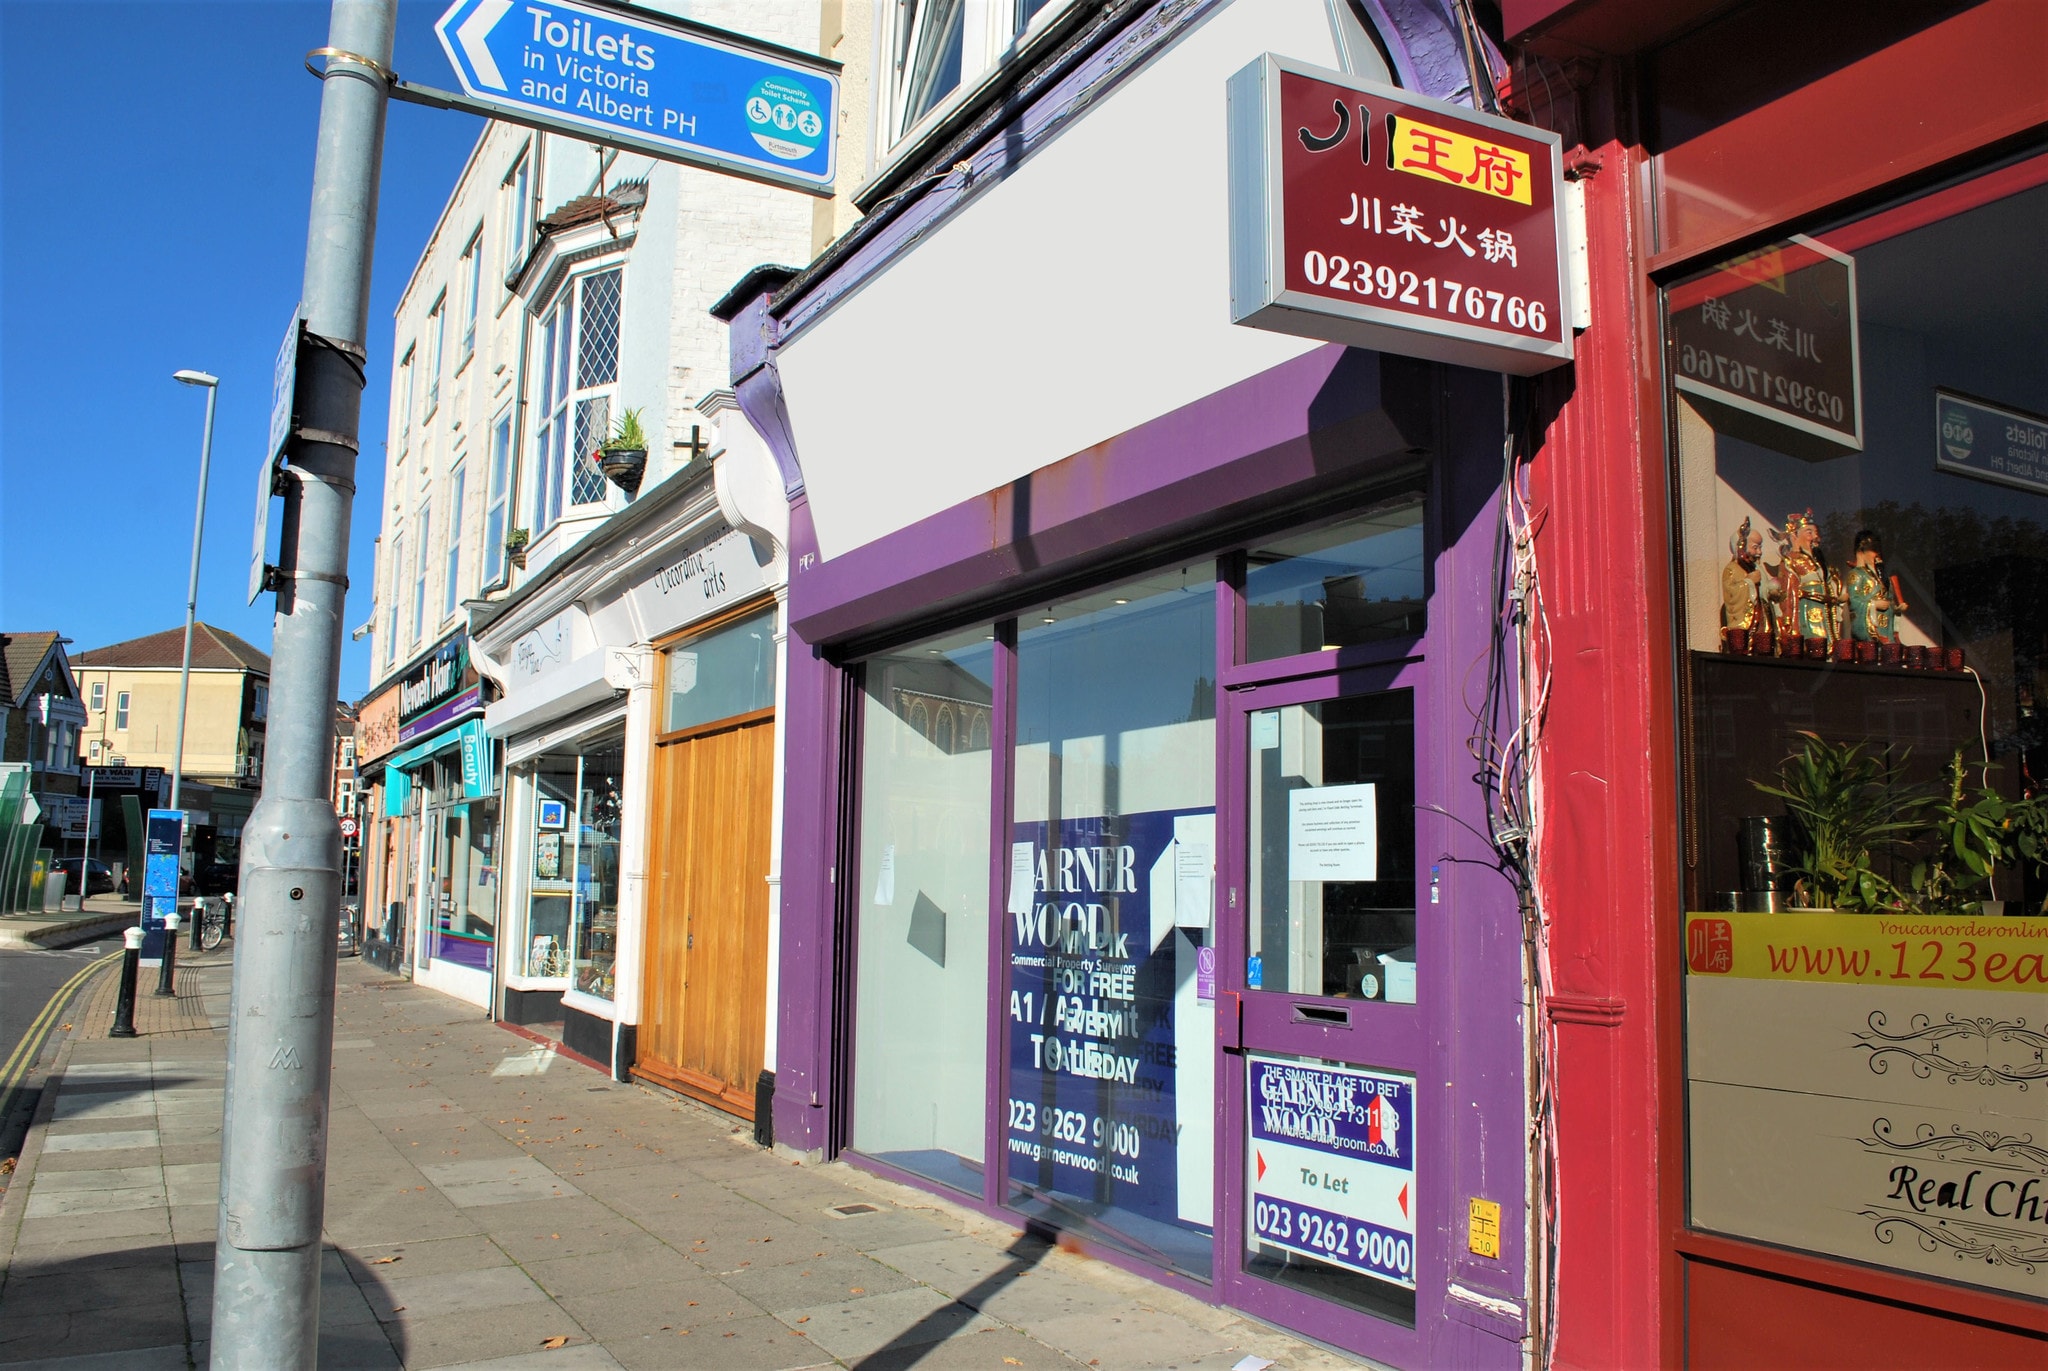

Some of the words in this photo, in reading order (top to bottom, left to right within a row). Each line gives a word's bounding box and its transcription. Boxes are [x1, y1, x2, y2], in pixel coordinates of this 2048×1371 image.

[526, 6, 655, 71] Toilets
[523, 45, 545, 71] in
[556, 53, 649, 98] Victoria
[764, 81, 807, 99] Community
[520, 78, 567, 105] and
[577, 88, 653, 127] Albert
[663, 109, 696, 137] PH
[760, 87, 781, 99] Toilet
[782, 94, 811, 107] Scheme
[1340, 192, 1518, 268] 川菜火锅
[1303, 250, 1547, 333] 02392176766
[654, 548, 708, 595] Decorative
[464, 734, 478, 786] Beauty
[342, 823, 354, 832] 20
[1033, 845, 1138, 893] ARNER
[1053, 968, 1086, 996] FOR
[1089, 971, 1135, 1001] FREE
[1057, 957, 1094, 974] Property
[1096, 959, 1136, 975] Surveyors
[1010, 990, 1032, 1023] A1
[1064, 1007, 1121, 1040] EVERY
[1260, 1073, 1355, 1114] GARNER
[1263, 1065, 1282, 1078] THE
[1285, 1068, 1320, 1085] SMART
[1322, 1073, 1357, 1092] PLACE
[1359, 1079, 1375, 1094] TO
[1377, 1082, 1399, 1098] BET
[1041, 1106, 1086, 1145] 9262
[1092, 1116, 1139, 1159] 9000
[1261, 1105, 1336, 1141] WOOD
[1300, 1167, 1318, 1187] To
[1323, 1173, 1349, 1194] Let
[1886, 1165, 1982, 1212] Real
[1256, 1200, 1292, 1238] 023
[1299, 1212, 1349, 1256] 9262
[1355, 1227, 1410, 1273] 9000
